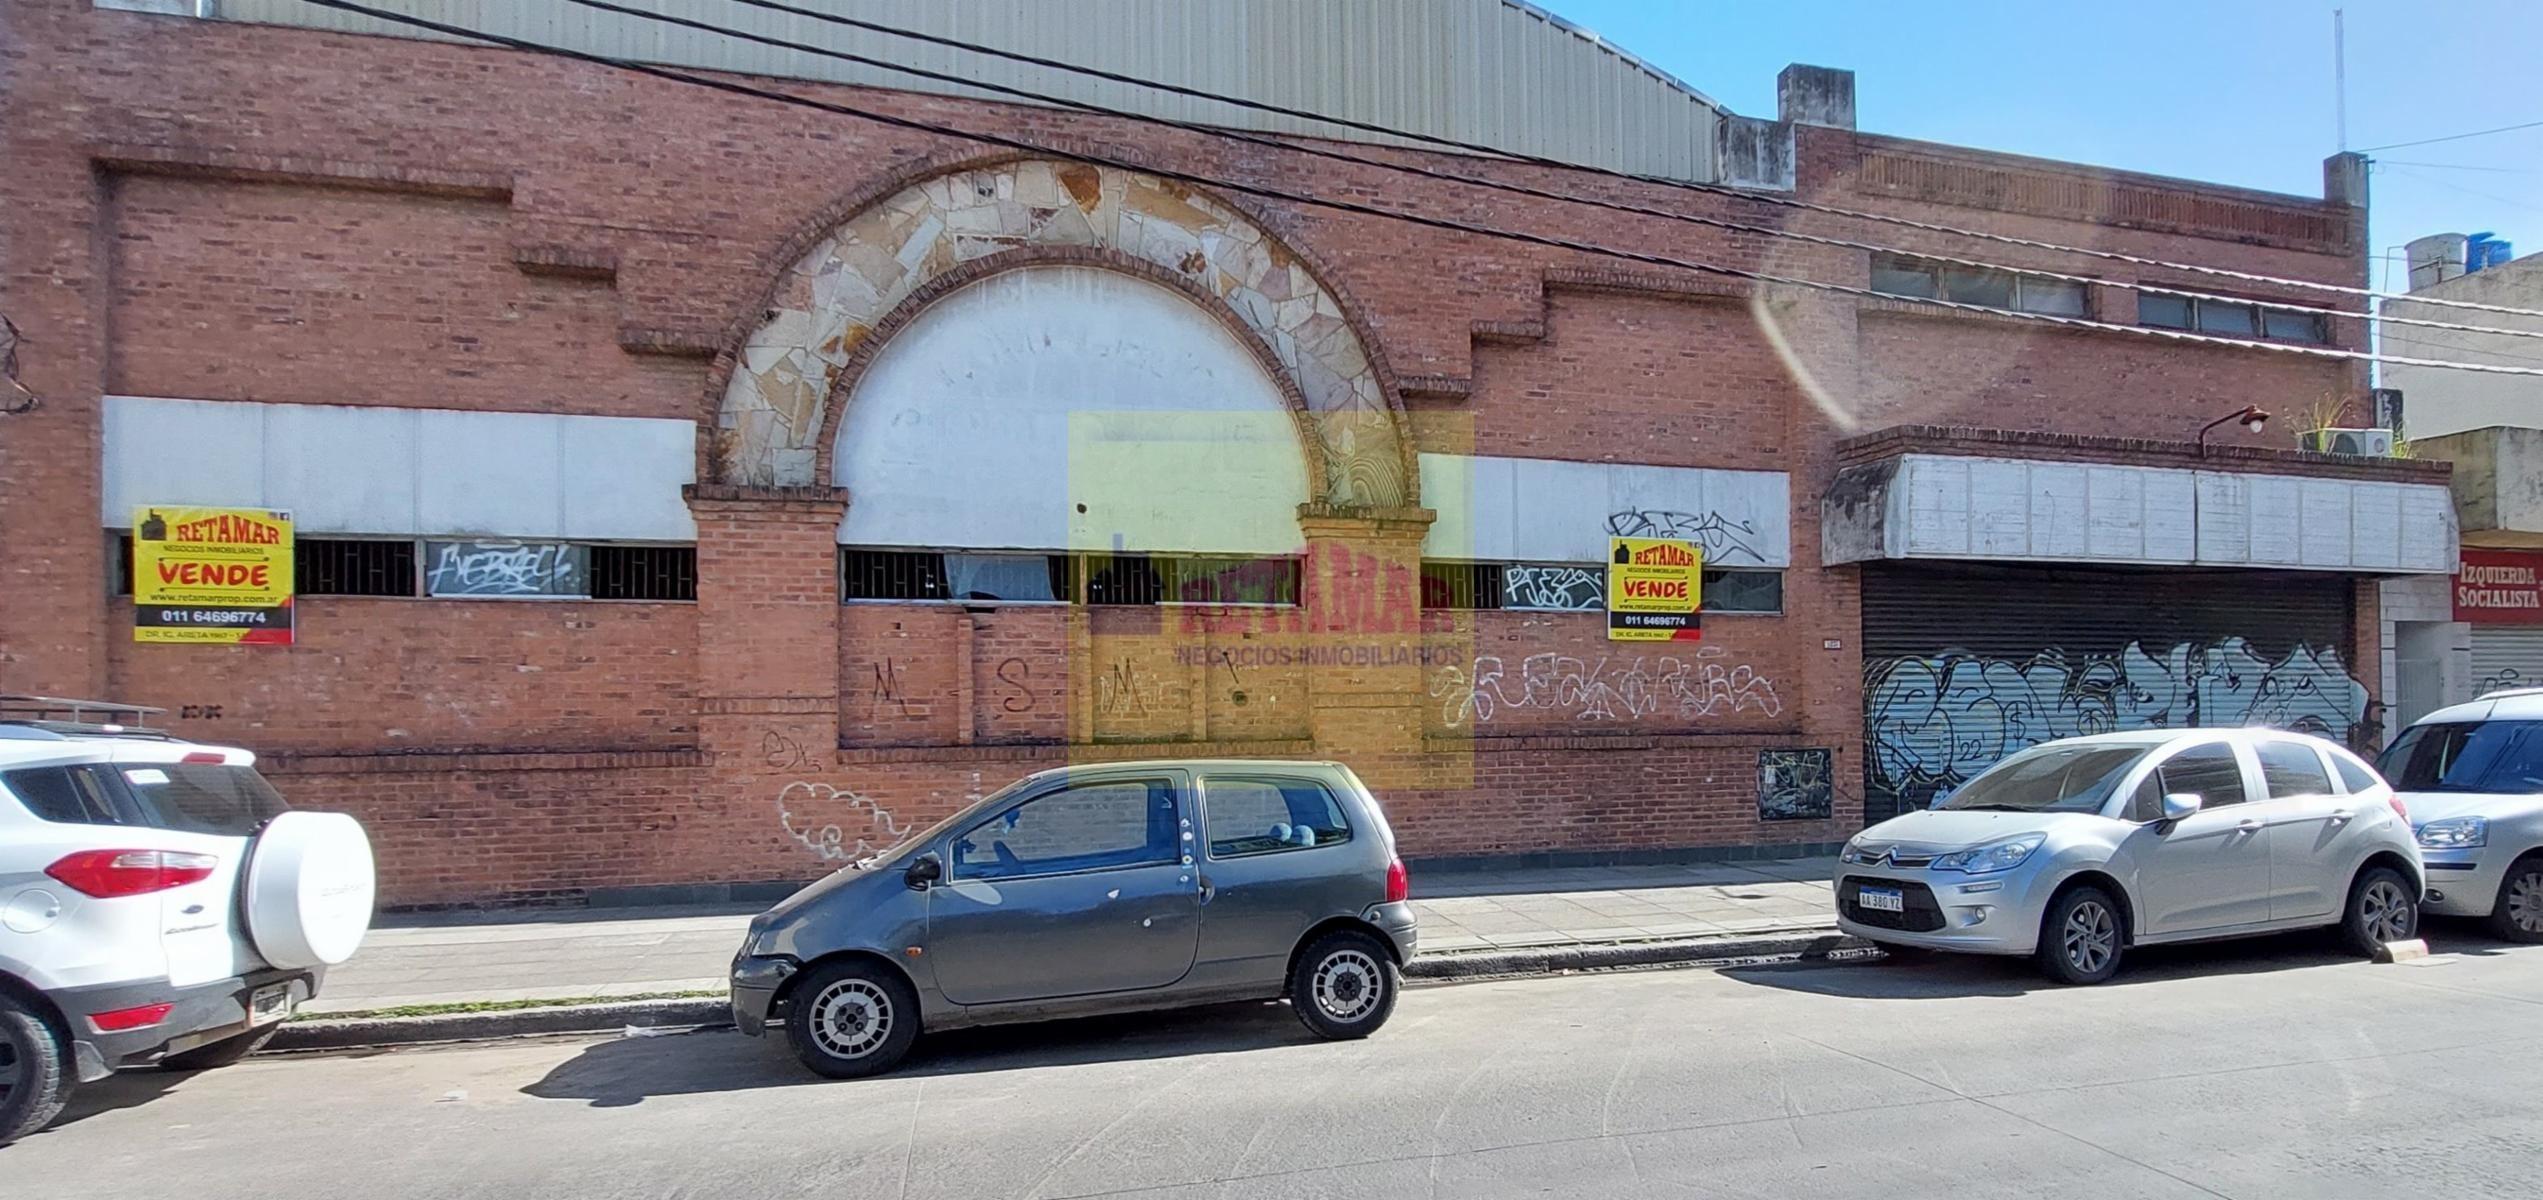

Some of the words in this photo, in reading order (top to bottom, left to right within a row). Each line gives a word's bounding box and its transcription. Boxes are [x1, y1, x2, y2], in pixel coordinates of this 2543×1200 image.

[176, 514, 280, 545] RETAMAR
[163, 545, 205, 554] NEGOCIOS
[206, 546, 264, 555] INMOBILIARIOS
[1634, 544, 1695, 567] RETAMAR
[158, 562, 269, 587] VENDE
[2460, 561, 2536, 587] IZQUIERDA
[150, 593, 279, 604] www.retamarprop.com.ar
[1624, 580, 1688, 598] VENDE
[2459, 586, 2539, 607] SOCIALISTA
[162, 610, 188, 622] 011
[193, 610, 266, 623] 64696774
[1625, 615, 1641, 625] 011
